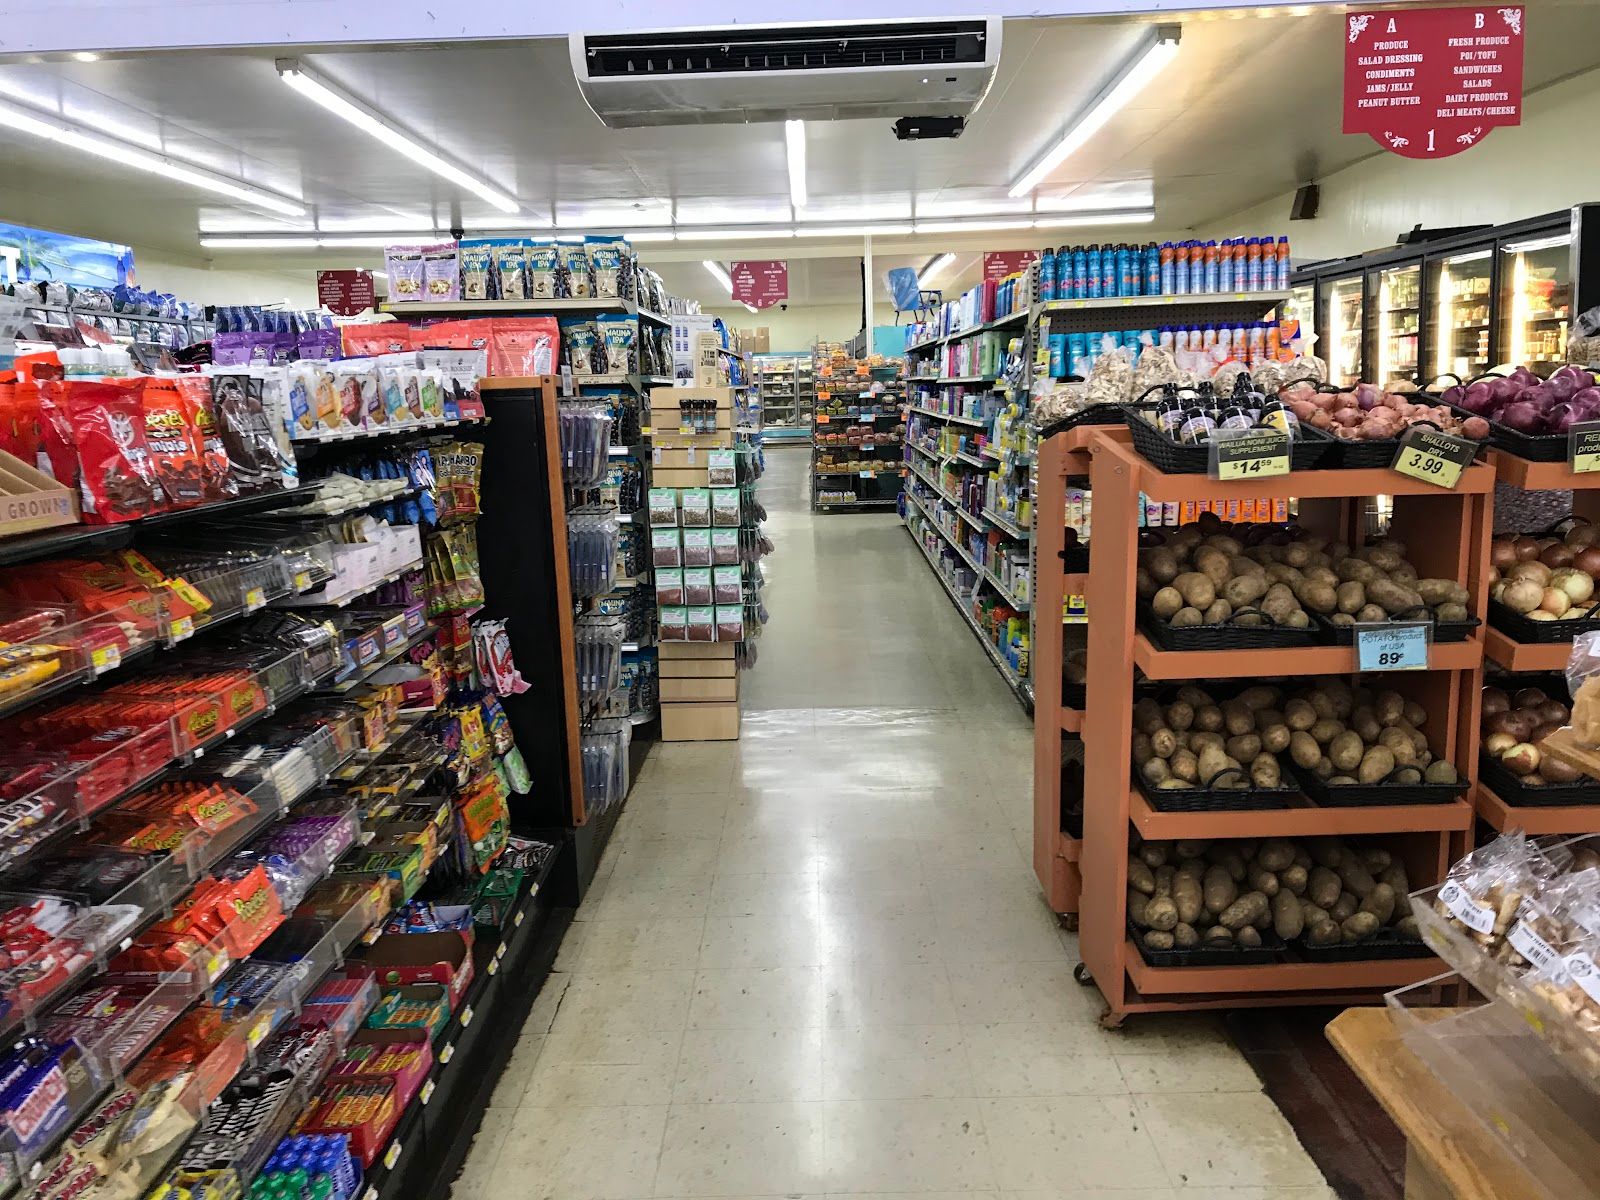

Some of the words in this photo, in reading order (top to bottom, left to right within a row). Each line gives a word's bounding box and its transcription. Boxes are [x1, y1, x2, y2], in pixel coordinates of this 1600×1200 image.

[1386, 17, 1397, 33] A
[1474, 13, 1485, 29] B
[1373, 40, 1409, 50] PRODUCE
[1448, 37, 1473, 47] FRESH
[1475, 36, 1509, 46] PRODUCE
[1358, 55, 1383, 66] SALAD
[1384, 53, 1423, 64] DRESSING
[1460, 50, 1497, 60] POI/TOFU
[1365, 68, 1415, 79] CONDIMENTS
[1453, 64, 1502, 75] SANDWICHES
[1366, 82, 1414, 93] JAMS/JELLY
[1462, 79, 1492, 88] SALADS
[1357, 97, 1388, 108] PEANUT
[1390, 96, 1421, 106] BUTTER
[1445, 93, 1468, 103] DAIRY
[1469, 92, 1508, 102] PRODUCTS
[1436, 108, 1455, 118] DELI
[1456, 106, 1516, 117] MEATS/CHEESE
[1426, 129, 1436, 152] 1
[531, 252, 556, 261] MAUNA
[593, 250, 618, 259] MAUNA
[537, 260, 549, 268] LOA
[600, 258, 612, 266] LOA
[605, 329, 631, 337] MAUNA
[612, 336, 624, 344] LOA
[1220, 441, 1246, 449] WAILUA
[1247, 438, 1265, 447] NONI
[1266, 435, 1287, 444] JUICE
[1420, 434, 1460, 453] SHALLOTS
[1229, 444, 1277, 455] SUPPLEMENT
[1427, 447, 1445, 457] DRY
[1409, 453, 1443, 474] 3.99
